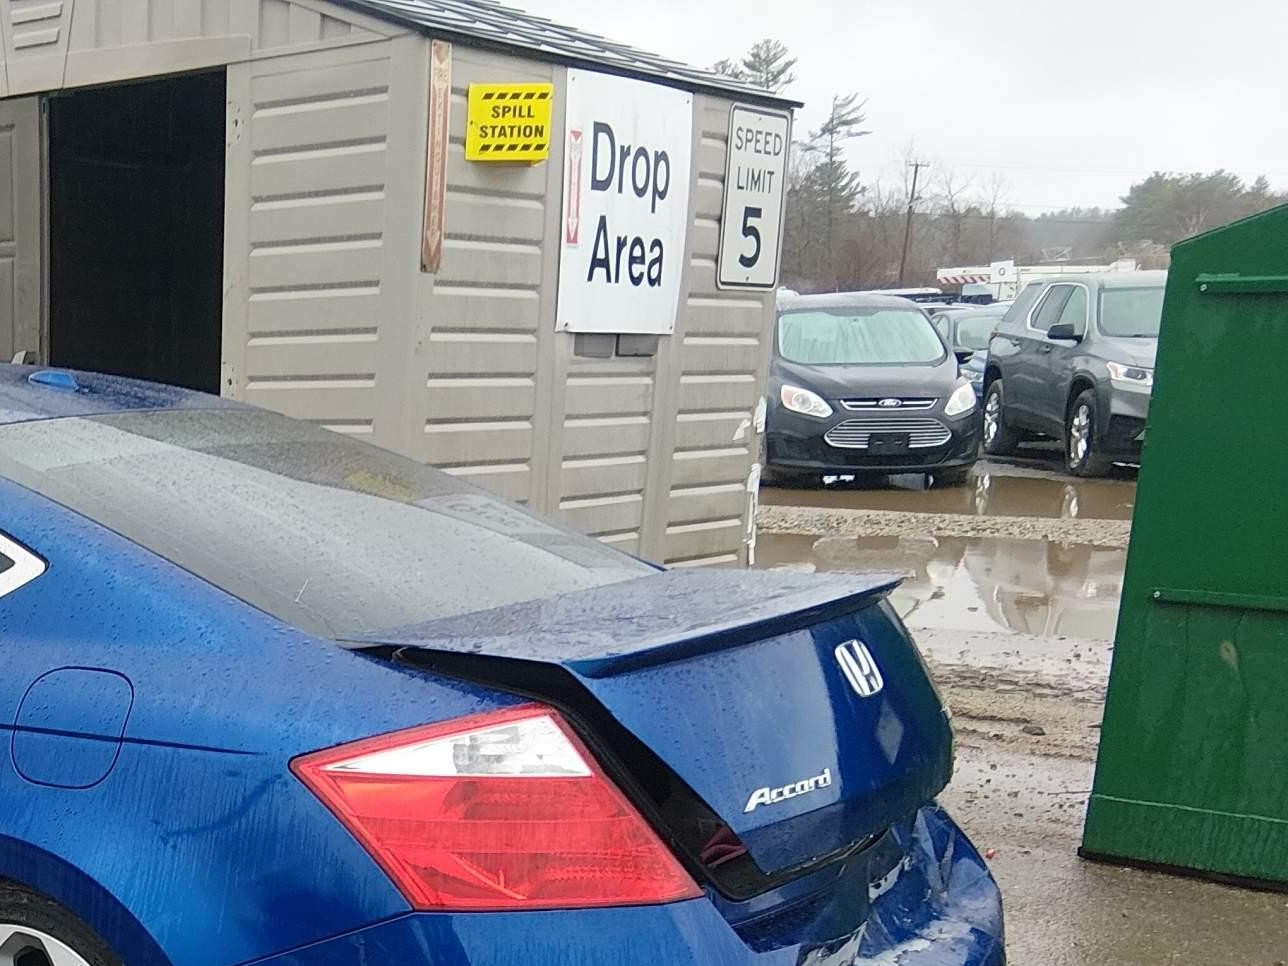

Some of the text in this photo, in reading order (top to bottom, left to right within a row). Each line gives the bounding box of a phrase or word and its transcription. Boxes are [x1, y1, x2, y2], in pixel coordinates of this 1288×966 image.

[491, 105, 535, 119] SPILL
[479, 125, 545, 139] STATION
[734, 126, 783, 158] SPEED
[590, 121, 670, 214] Drop
[736, 165, 775, 195] LIMIT
[586, 215, 664, 288] Area
[738, 206, 763, 268] 5
[743, 768, 832, 813] Accord
